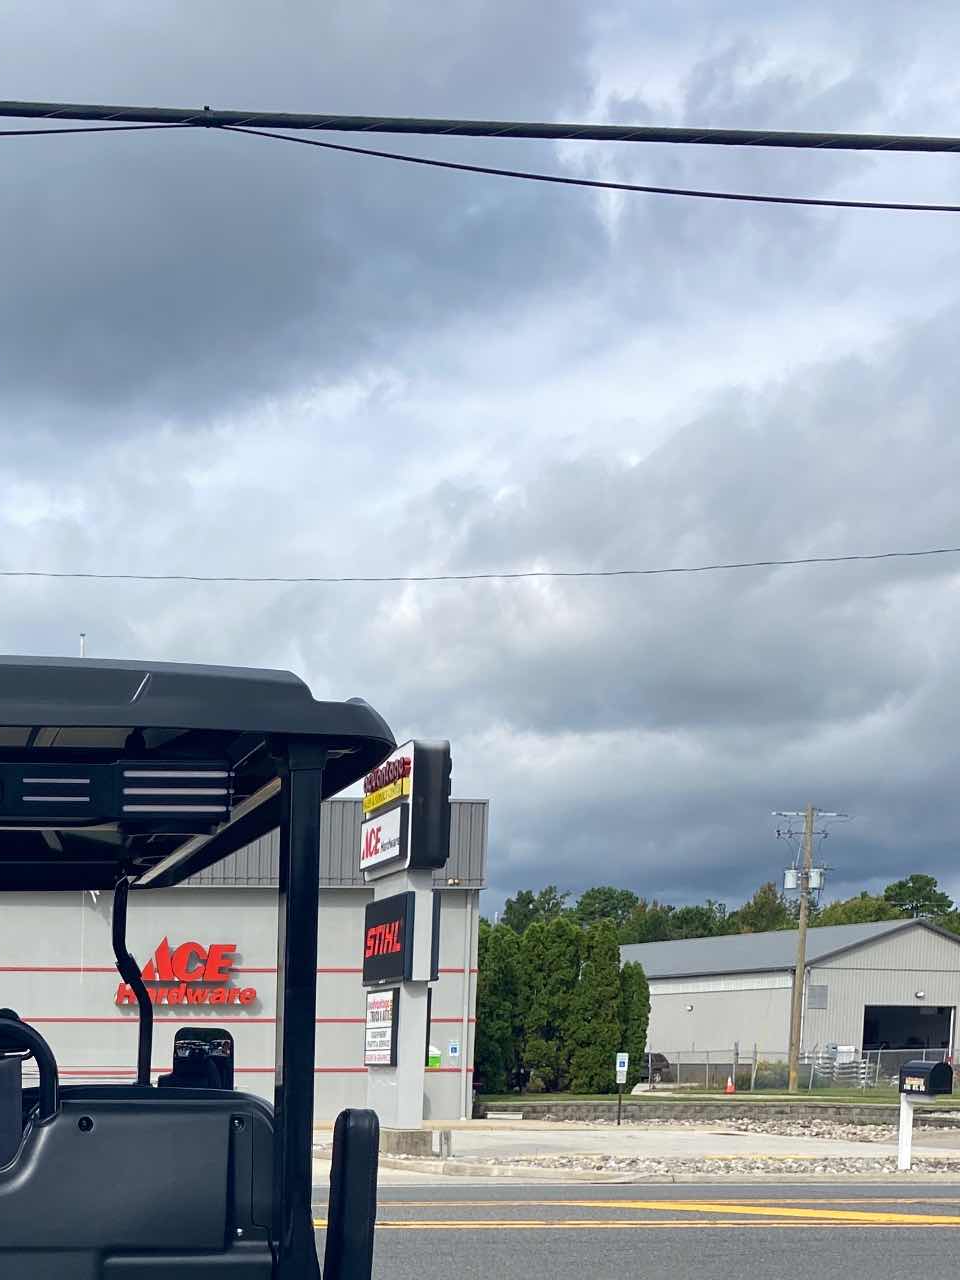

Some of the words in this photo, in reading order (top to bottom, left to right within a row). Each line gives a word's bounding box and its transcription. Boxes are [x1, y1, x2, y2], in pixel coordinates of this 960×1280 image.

[362, 826, 381, 860] ACE
[365, 921, 401, 958] STIHL
[141, 936, 237, 983] ACE
[115, 982, 257, 1005] Hrdware
